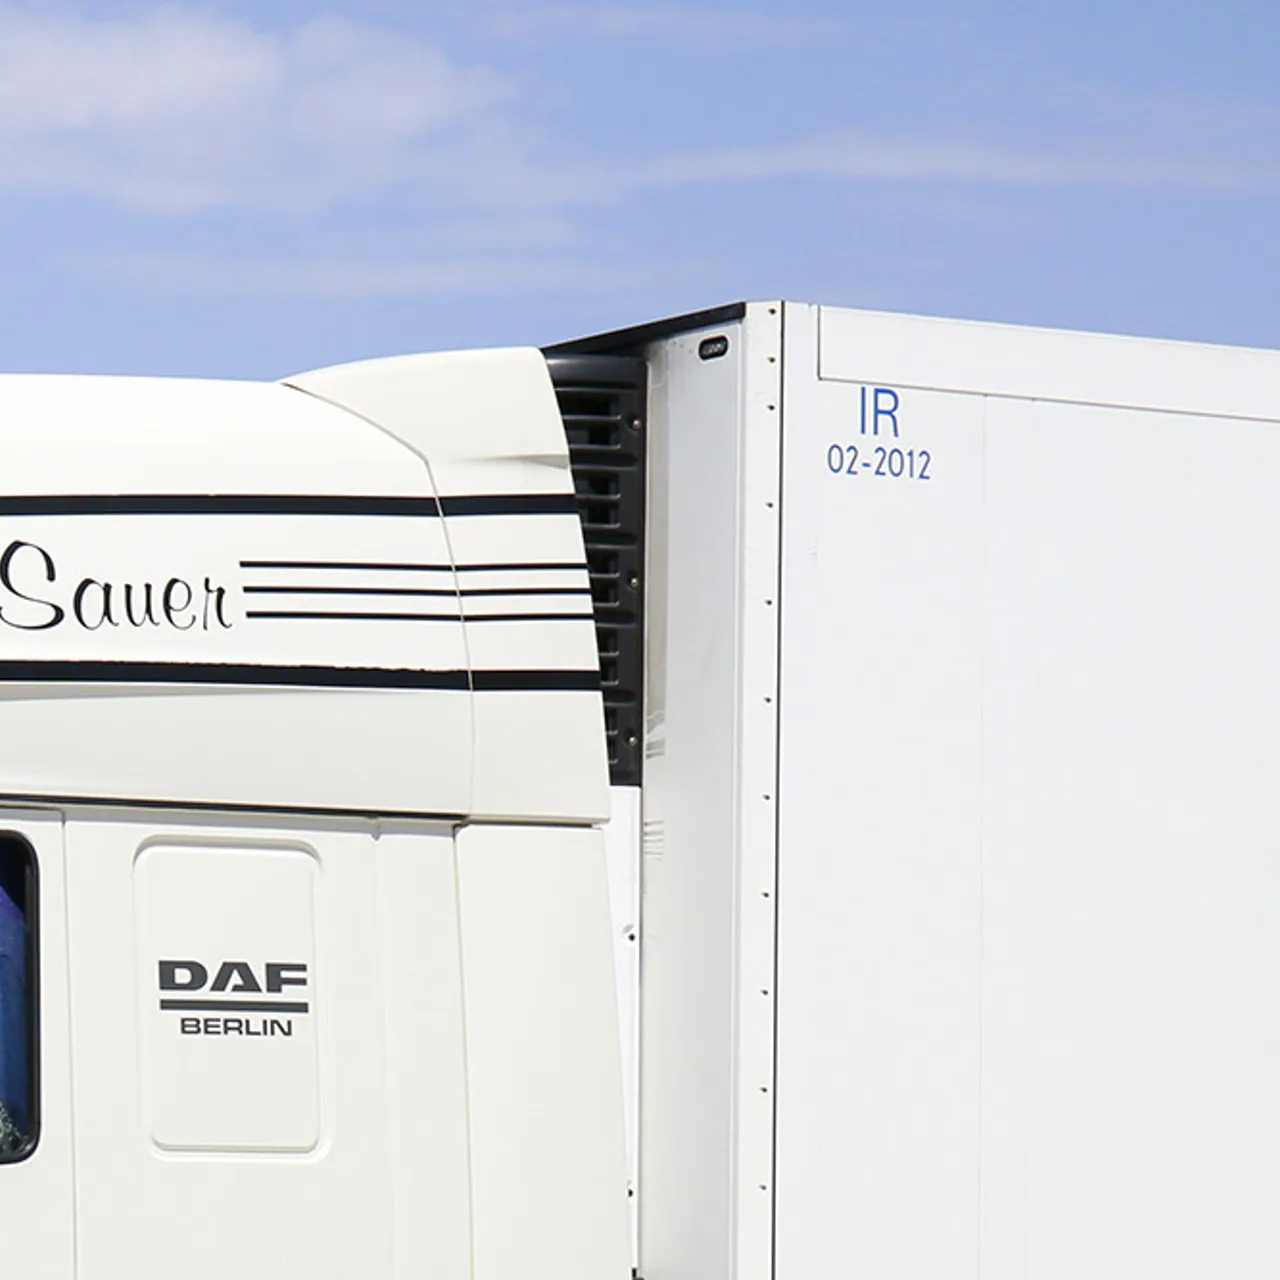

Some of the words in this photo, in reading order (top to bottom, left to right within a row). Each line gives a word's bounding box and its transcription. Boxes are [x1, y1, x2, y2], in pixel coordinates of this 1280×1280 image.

[860, 386, 900, 438] IR
[826, 443, 932, 481] 02-2012
[158, 959, 308, 994] DAF
[179, 1017, 293, 1037] BERLIN
